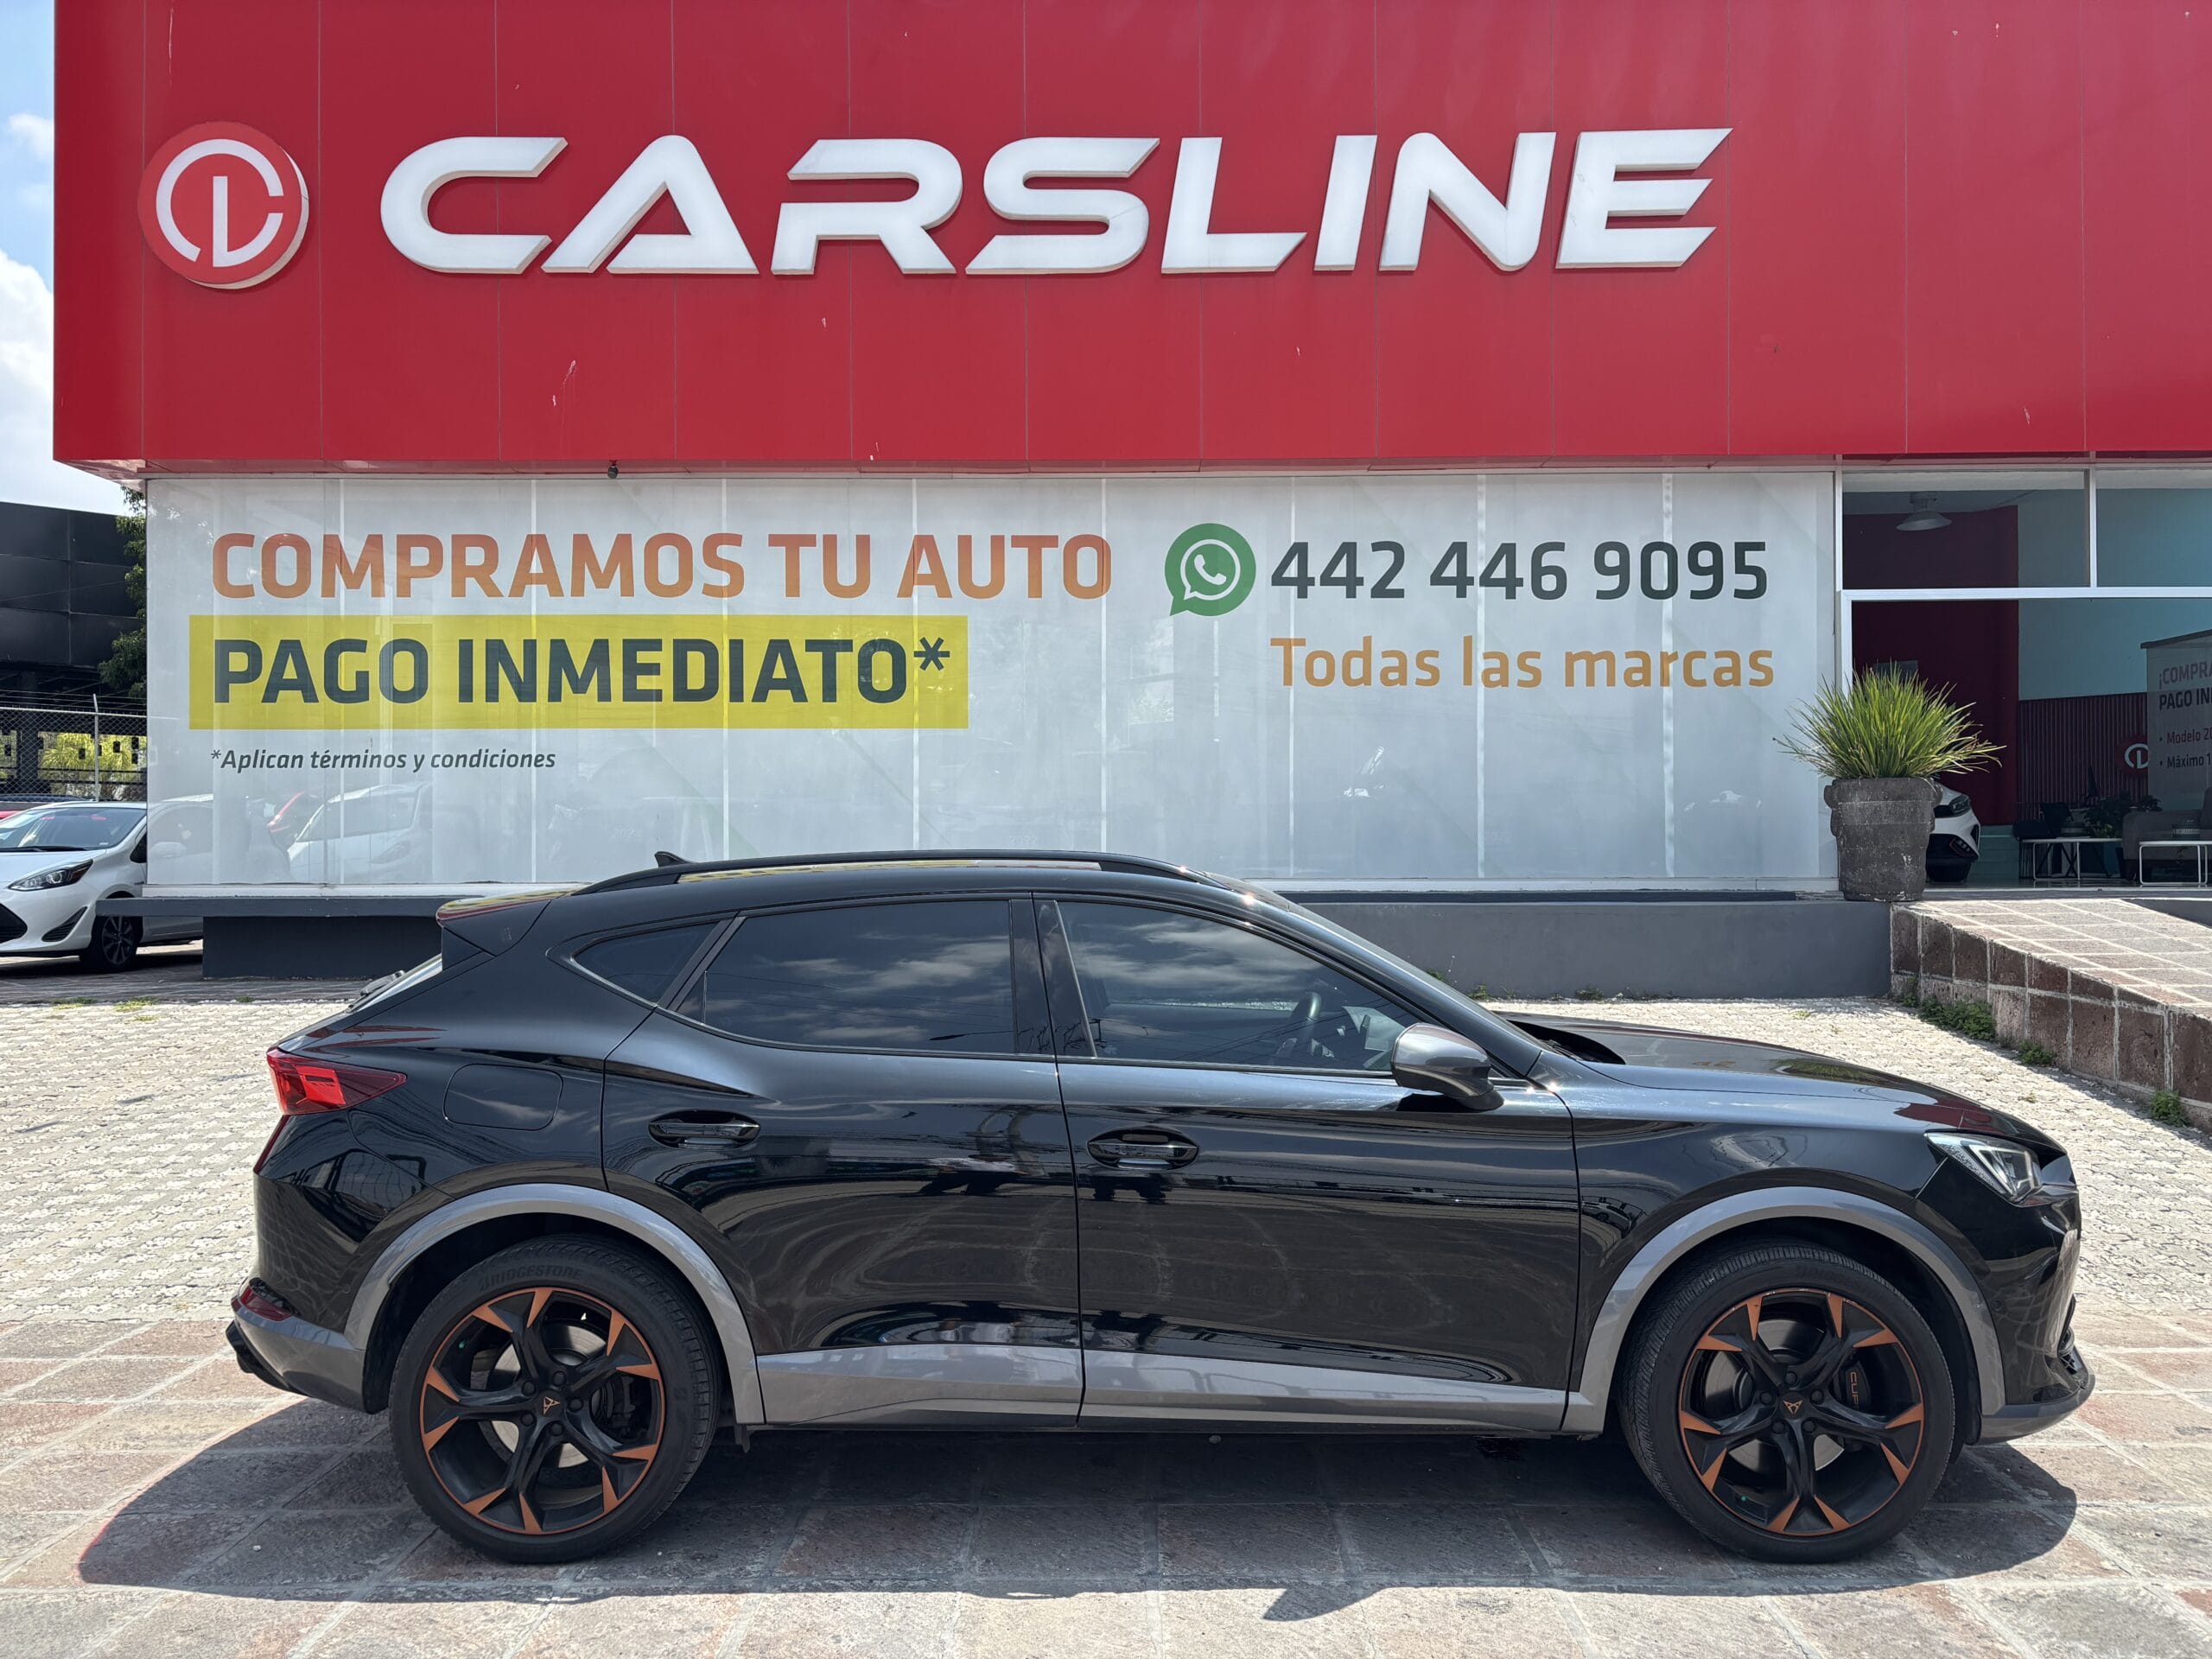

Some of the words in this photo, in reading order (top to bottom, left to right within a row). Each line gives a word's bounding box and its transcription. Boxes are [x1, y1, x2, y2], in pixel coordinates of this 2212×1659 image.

[380, 128, 1733, 276] CARSLINE
[212, 533, 745, 599] COMPRAMOS
[768, 533, 871, 599] TU
[897, 534, 1112, 600] AUTO
[1270, 540, 1406, 599] 442
[1429, 541, 1567, 601] 446
[1593, 541, 1767, 601] 9095
[213, 638, 429, 704] PAGO
[1270, 635, 1440, 688] Todas
[1462, 635, 1542, 688] las
[1565, 649, 1774, 688] marcas
[2159, 690, 2193, 710] PAGO
[2196, 687, 2212, 705] IN
[310, 749, 406, 769] términos
[412, 753, 425, 773] y
[430, 748, 556, 768] condiciones
[2166, 728, 2201, 744] Modelo
[2166, 753, 2204, 769] Máximo
